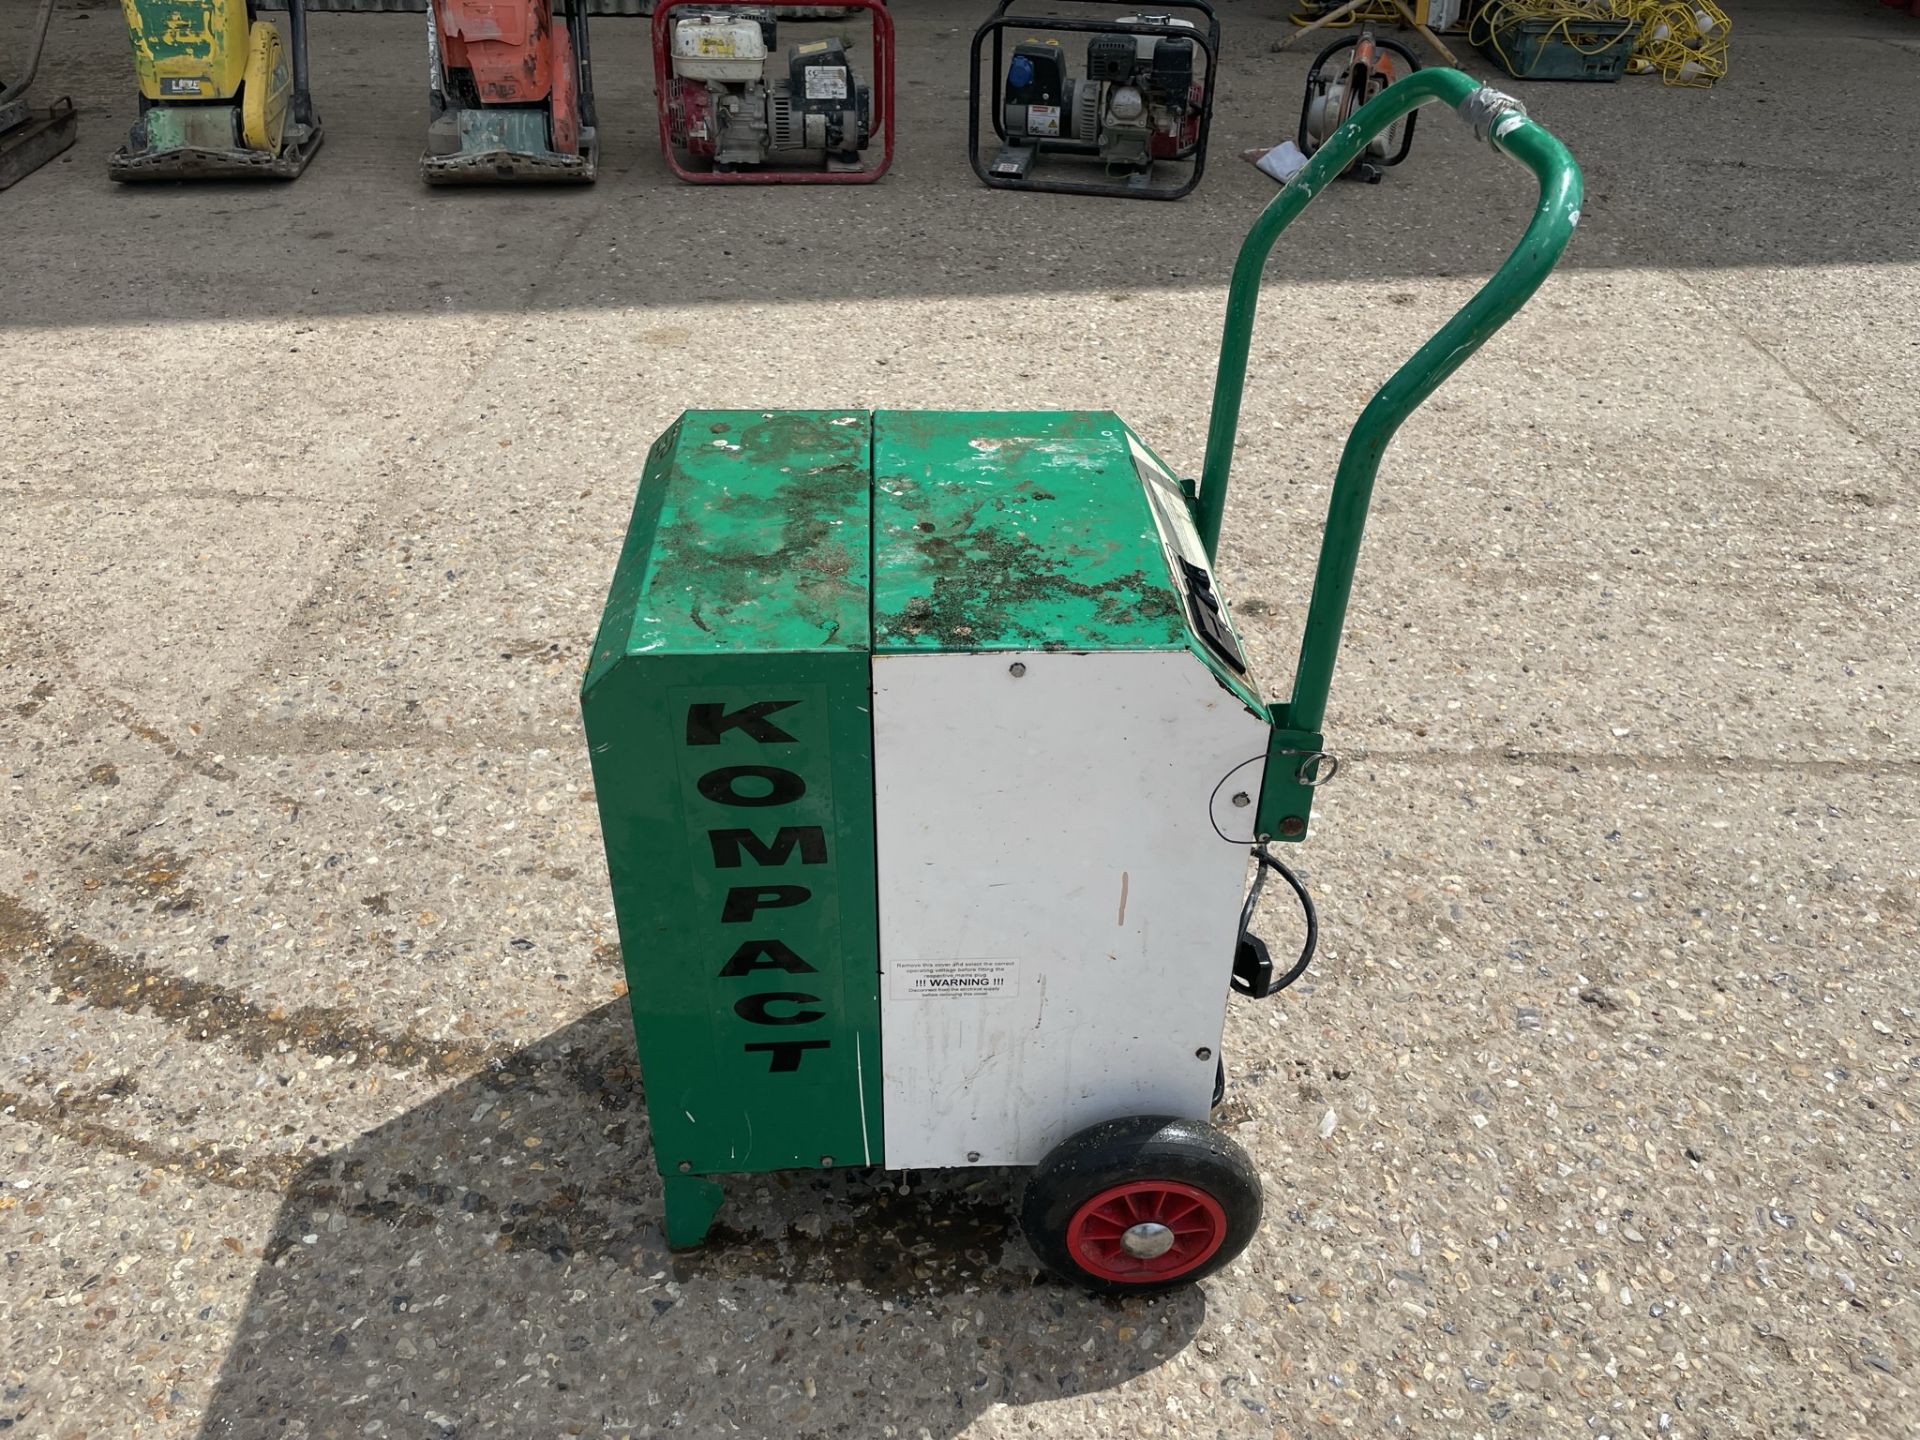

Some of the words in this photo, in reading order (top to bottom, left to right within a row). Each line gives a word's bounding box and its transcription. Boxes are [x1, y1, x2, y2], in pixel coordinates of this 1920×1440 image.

[686, 700, 831, 1073] KOMPACT
[915, 979, 926, 987] !!!
[929, 978, 989, 987] WARNING
[993, 978, 1004, 986] !!!
